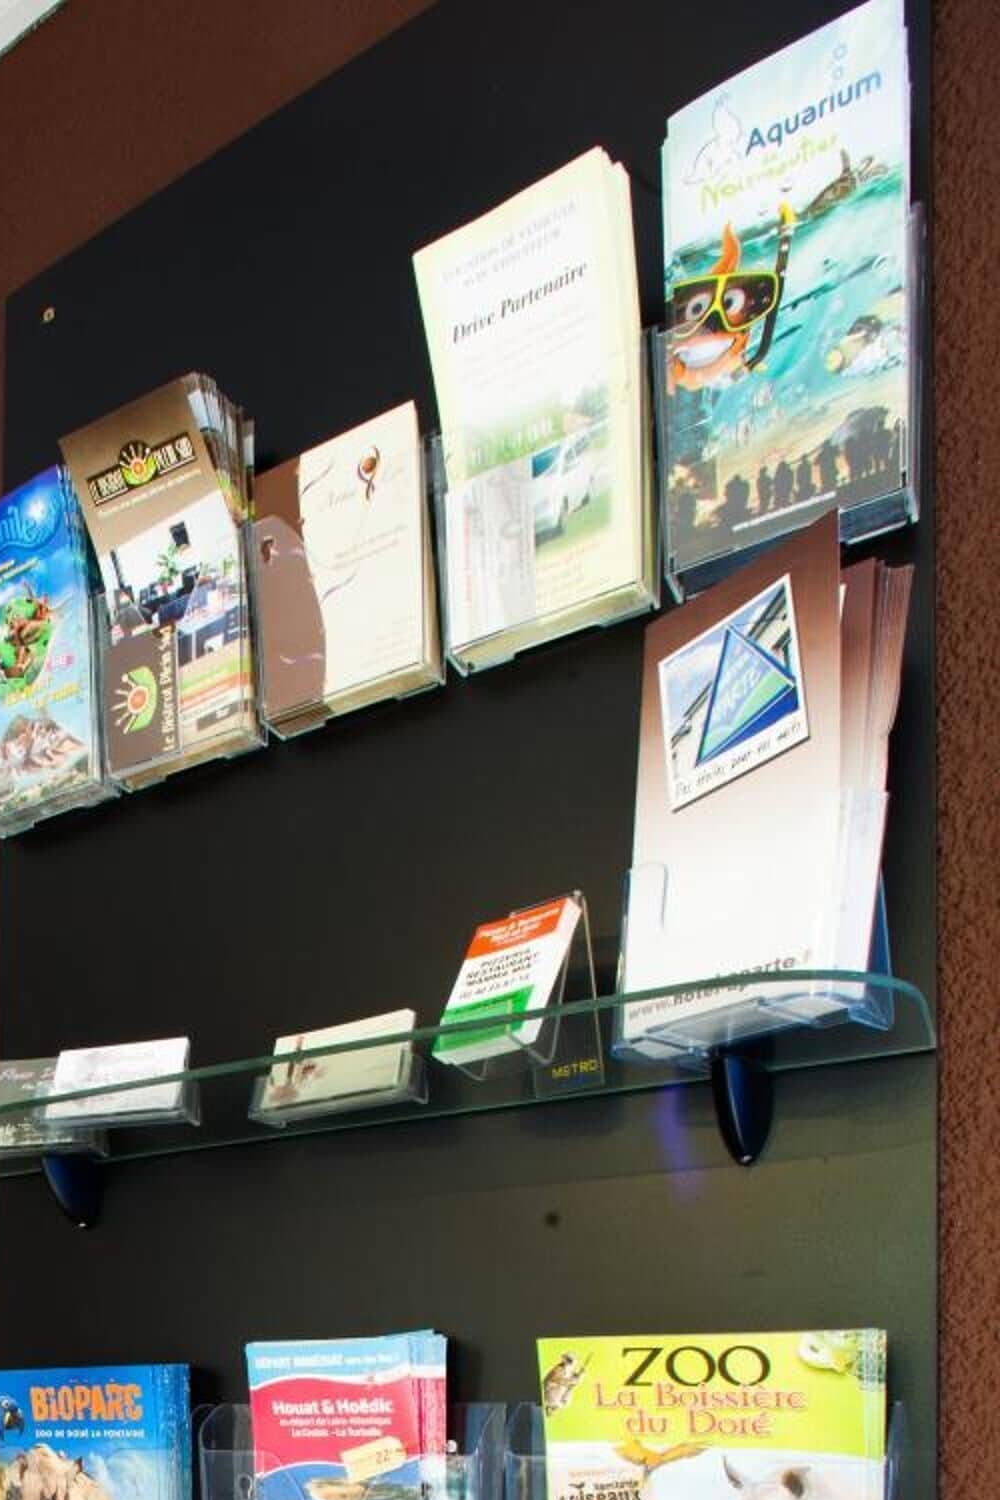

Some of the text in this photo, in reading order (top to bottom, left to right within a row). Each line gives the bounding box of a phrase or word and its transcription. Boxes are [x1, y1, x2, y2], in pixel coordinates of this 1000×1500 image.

[745, 70, 883, 158] Aquarium
[453, 262, 588, 344] Drive Partenaire
[552, 1059, 598, 1077] METRO
[622, 1345, 772, 1387] ZOO
[271, 1399, 319, 1415] Houat
[321, 1398, 335, 1415] &
[594, 1382, 806, 1410] La Boissière
[625, 1409, 772, 1436] du Doré
